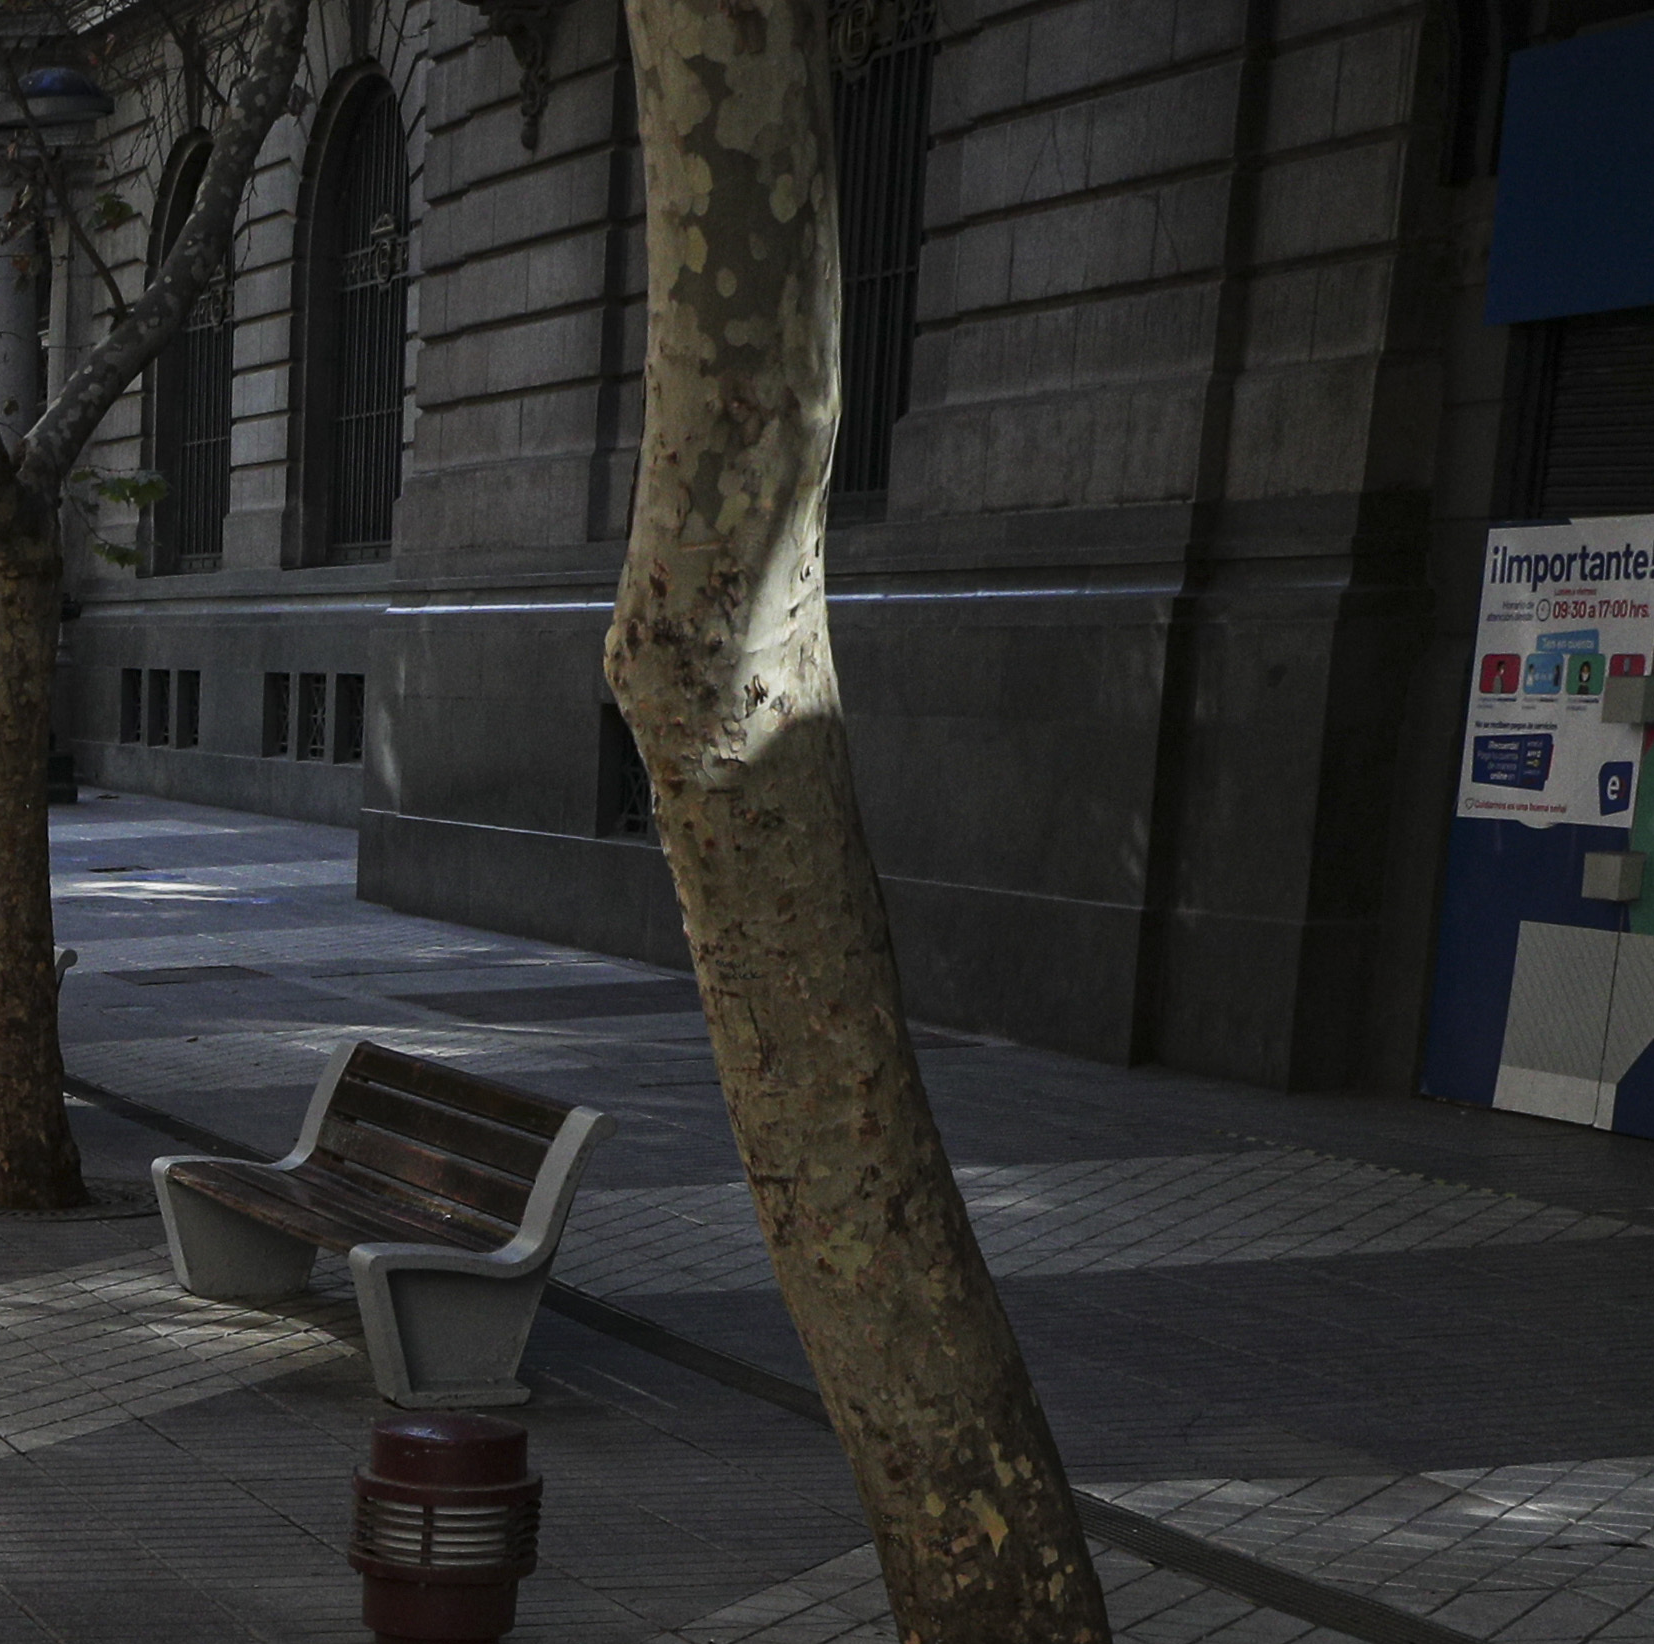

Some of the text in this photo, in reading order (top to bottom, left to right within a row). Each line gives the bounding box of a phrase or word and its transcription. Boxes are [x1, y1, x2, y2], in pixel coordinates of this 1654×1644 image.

[1553, 601, 1587, 619] 09:30
[1588, 606, 1596, 618] a
[1598, 600, 1628, 618] 17:00
